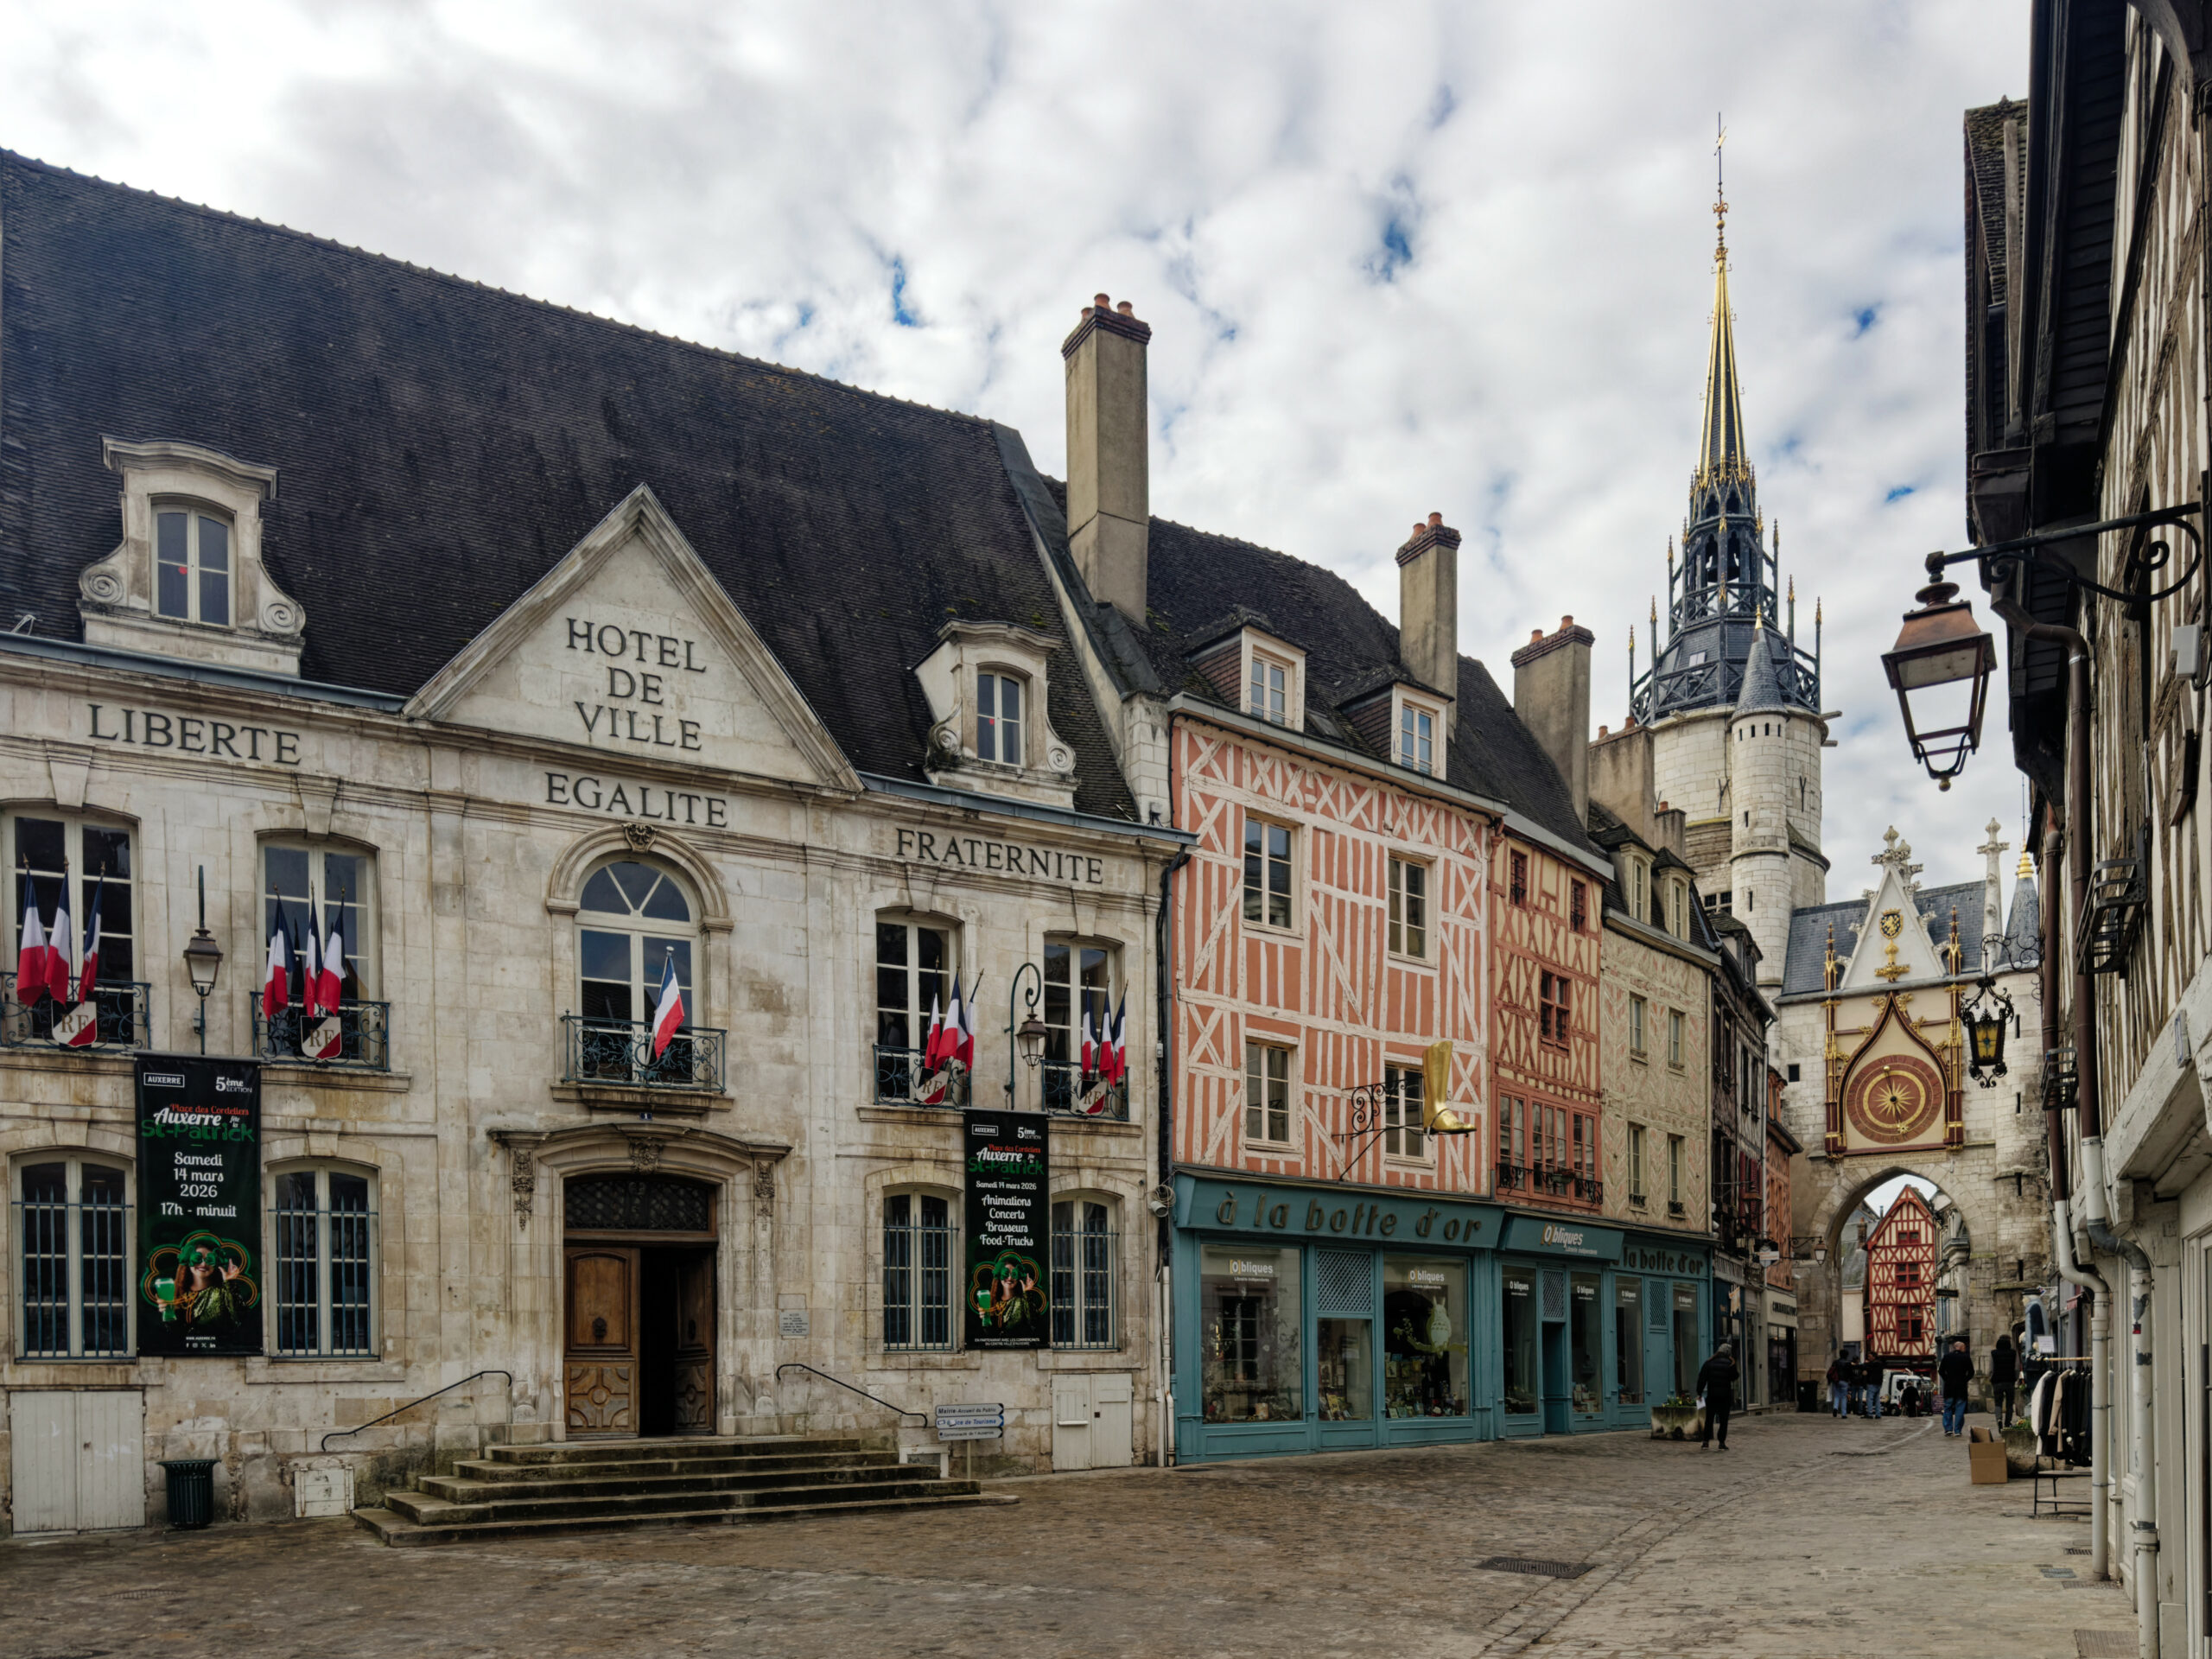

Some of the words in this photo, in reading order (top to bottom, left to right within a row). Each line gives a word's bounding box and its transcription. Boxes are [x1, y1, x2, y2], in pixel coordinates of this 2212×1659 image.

[566, 618, 707, 673] HOTEL
[607, 666, 664, 706] DE
[87, 703, 302, 766] LIBERTE
[574, 701, 702, 751] VILLE
[544, 772, 728, 828] EGALITE
[896, 828, 1103, 884] FRATERNITE
[61, 1014, 90, 1034] RF
[308, 1027, 335, 1048] RF
[147, 1076, 181, 1084] AUXERRE
[921, 1079, 942, 1096] RF
[1084, 1090, 1102, 1105] RF
[153, 1107, 222, 1126] Auxerre
[169, 1103, 193, 1113] Place
[211, 1105, 250, 1116] Cordeliers
[141, 1120, 255, 1142] St-Patrick
[175, 1152, 223, 1166] Samedi
[976, 1147, 1023, 1163] Auxerre
[173, 1168, 188, 1180] 14
[191, 1171, 224, 1182] mars
[969, 1157, 1045, 1176] St-Patrick
[180, 1184, 218, 1198] 2026
[976, 1180, 998, 1189] Samedi
[982, 1194, 1032, 1207] Animations
[161, 1202, 184, 1216] 17h
[196, 1205, 237, 1217] minuit
[989, 1208, 1026, 1219] Concerts
[1217, 1191, 1238, 1224] à
[1255, 1193, 1291, 1228] la
[1306, 1198, 1398, 1236] botte
[985, 1221, 1029, 1233] Brasseurs
[980, 1235, 1034, 1247] Food-Trucks
[1624, 1247, 1637, 1268] la
[1640, 1249, 1674, 1272] botte
